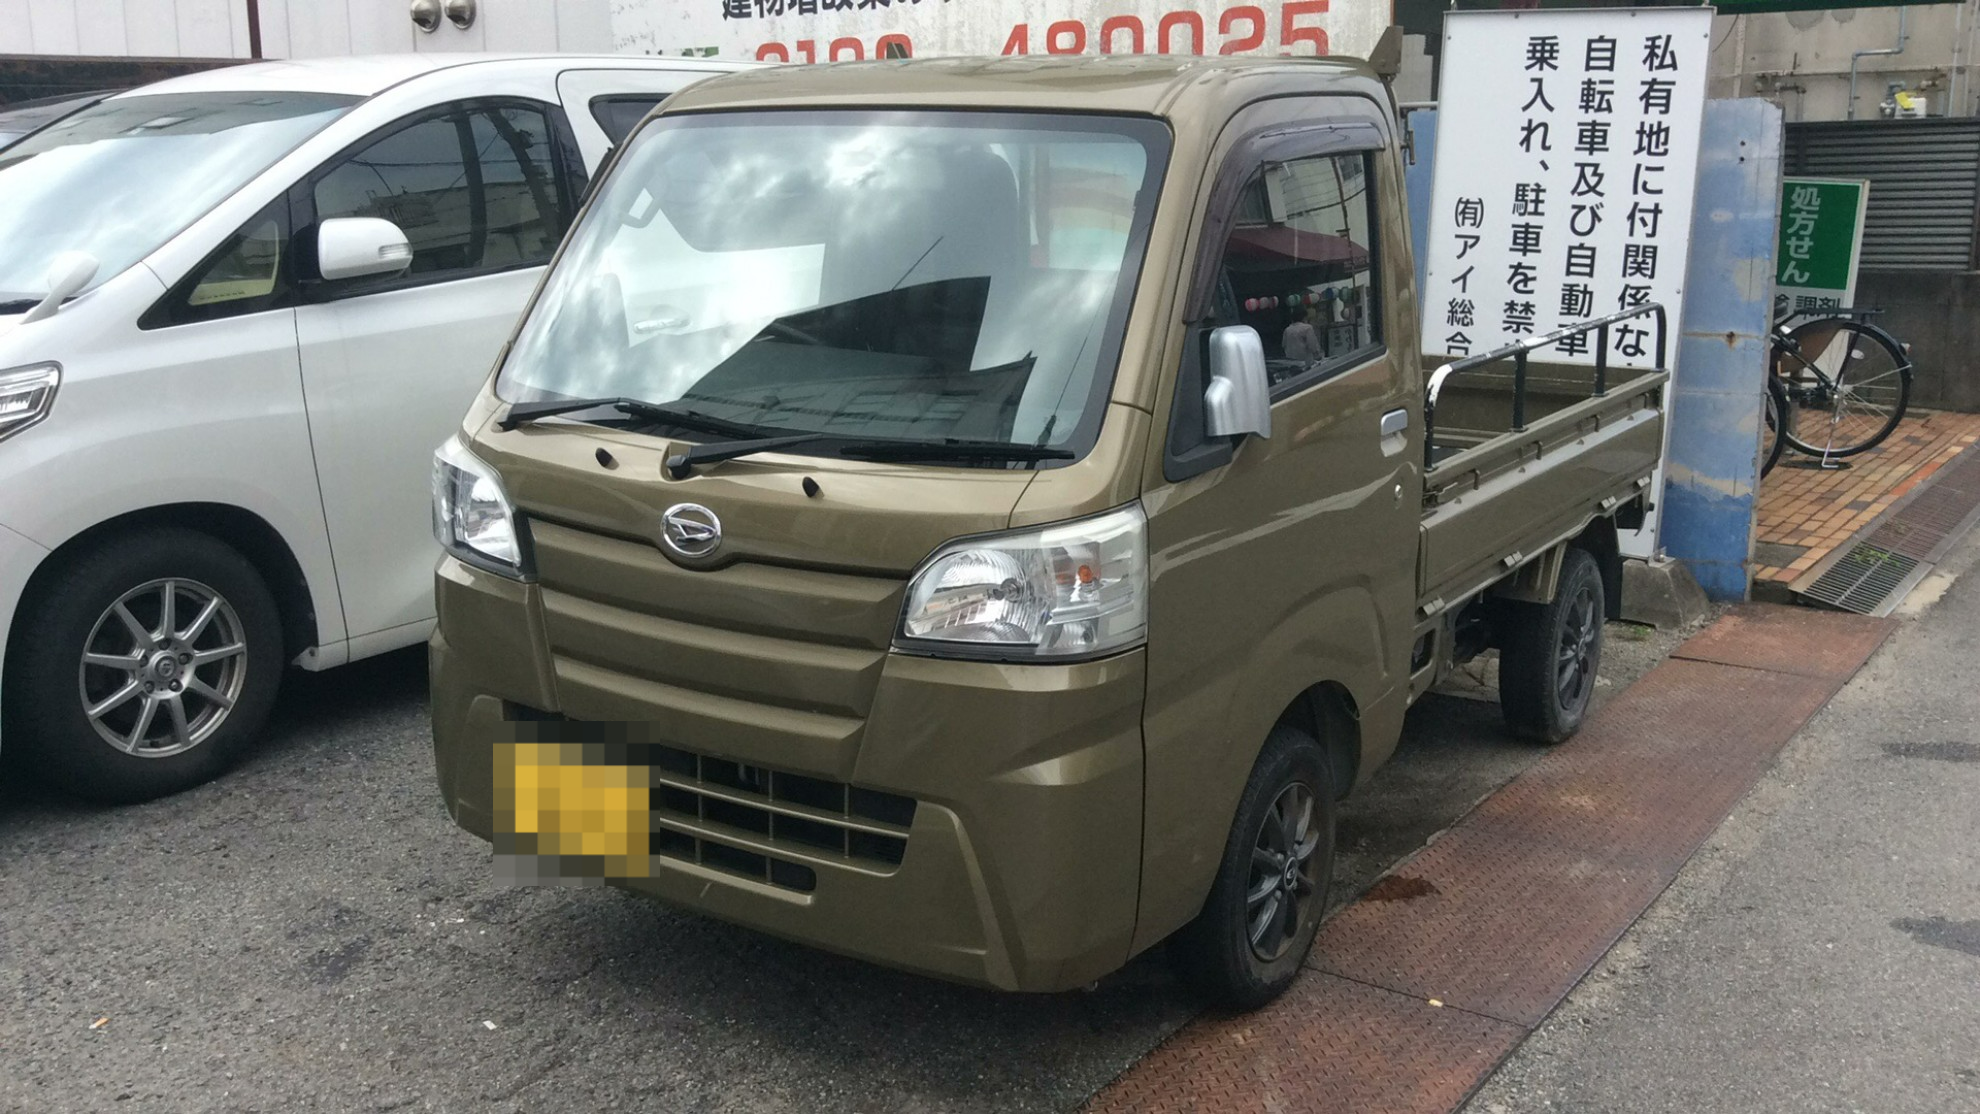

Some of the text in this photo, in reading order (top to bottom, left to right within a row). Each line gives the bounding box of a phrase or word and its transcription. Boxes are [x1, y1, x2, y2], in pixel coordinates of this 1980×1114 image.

[1501, 35, 1560, 348] 乗入れ、駐車を禁
[1554, 35, 1617, 357] 自転車及び自動車
[1614, 34, 1678, 366] 私有地に付関係な
[1781, 186, 1821, 284] 処方せん
